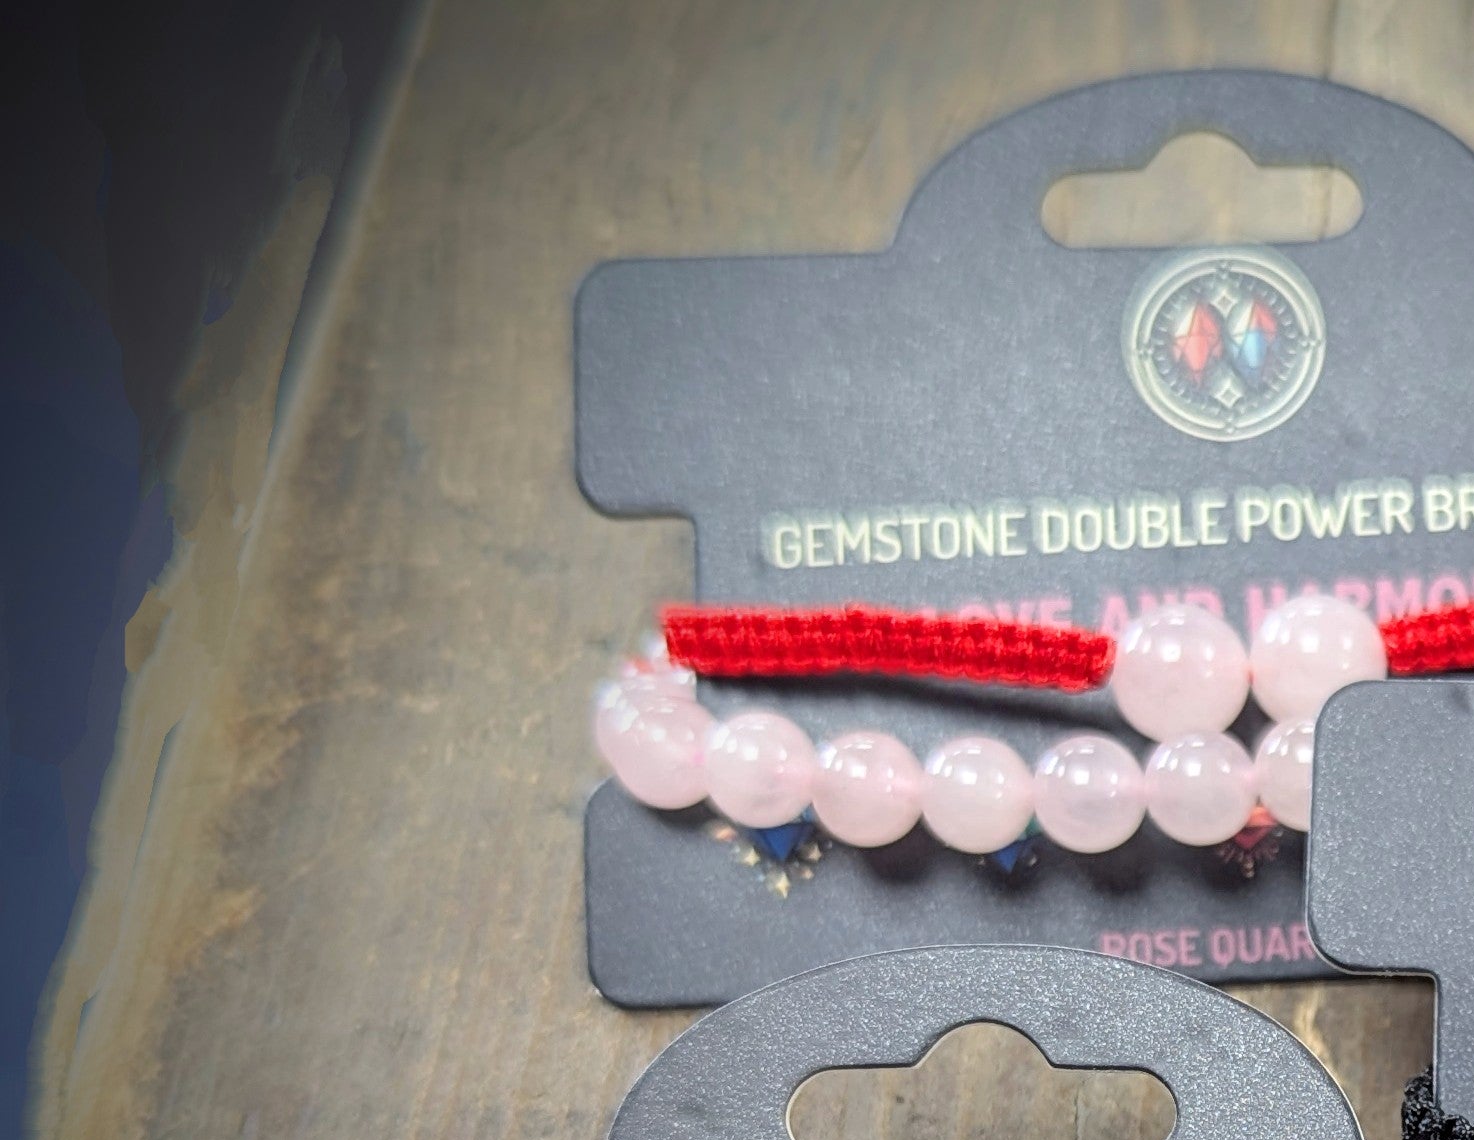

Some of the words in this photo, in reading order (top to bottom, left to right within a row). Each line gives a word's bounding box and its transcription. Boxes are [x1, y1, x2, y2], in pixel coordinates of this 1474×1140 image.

[771, 511, 1028, 569] GEMSTONE
[1041, 501, 1229, 554] DOUBLE
[1239, 484, 1413, 543] POWER
[1101, 928, 1201, 968] ROSE
